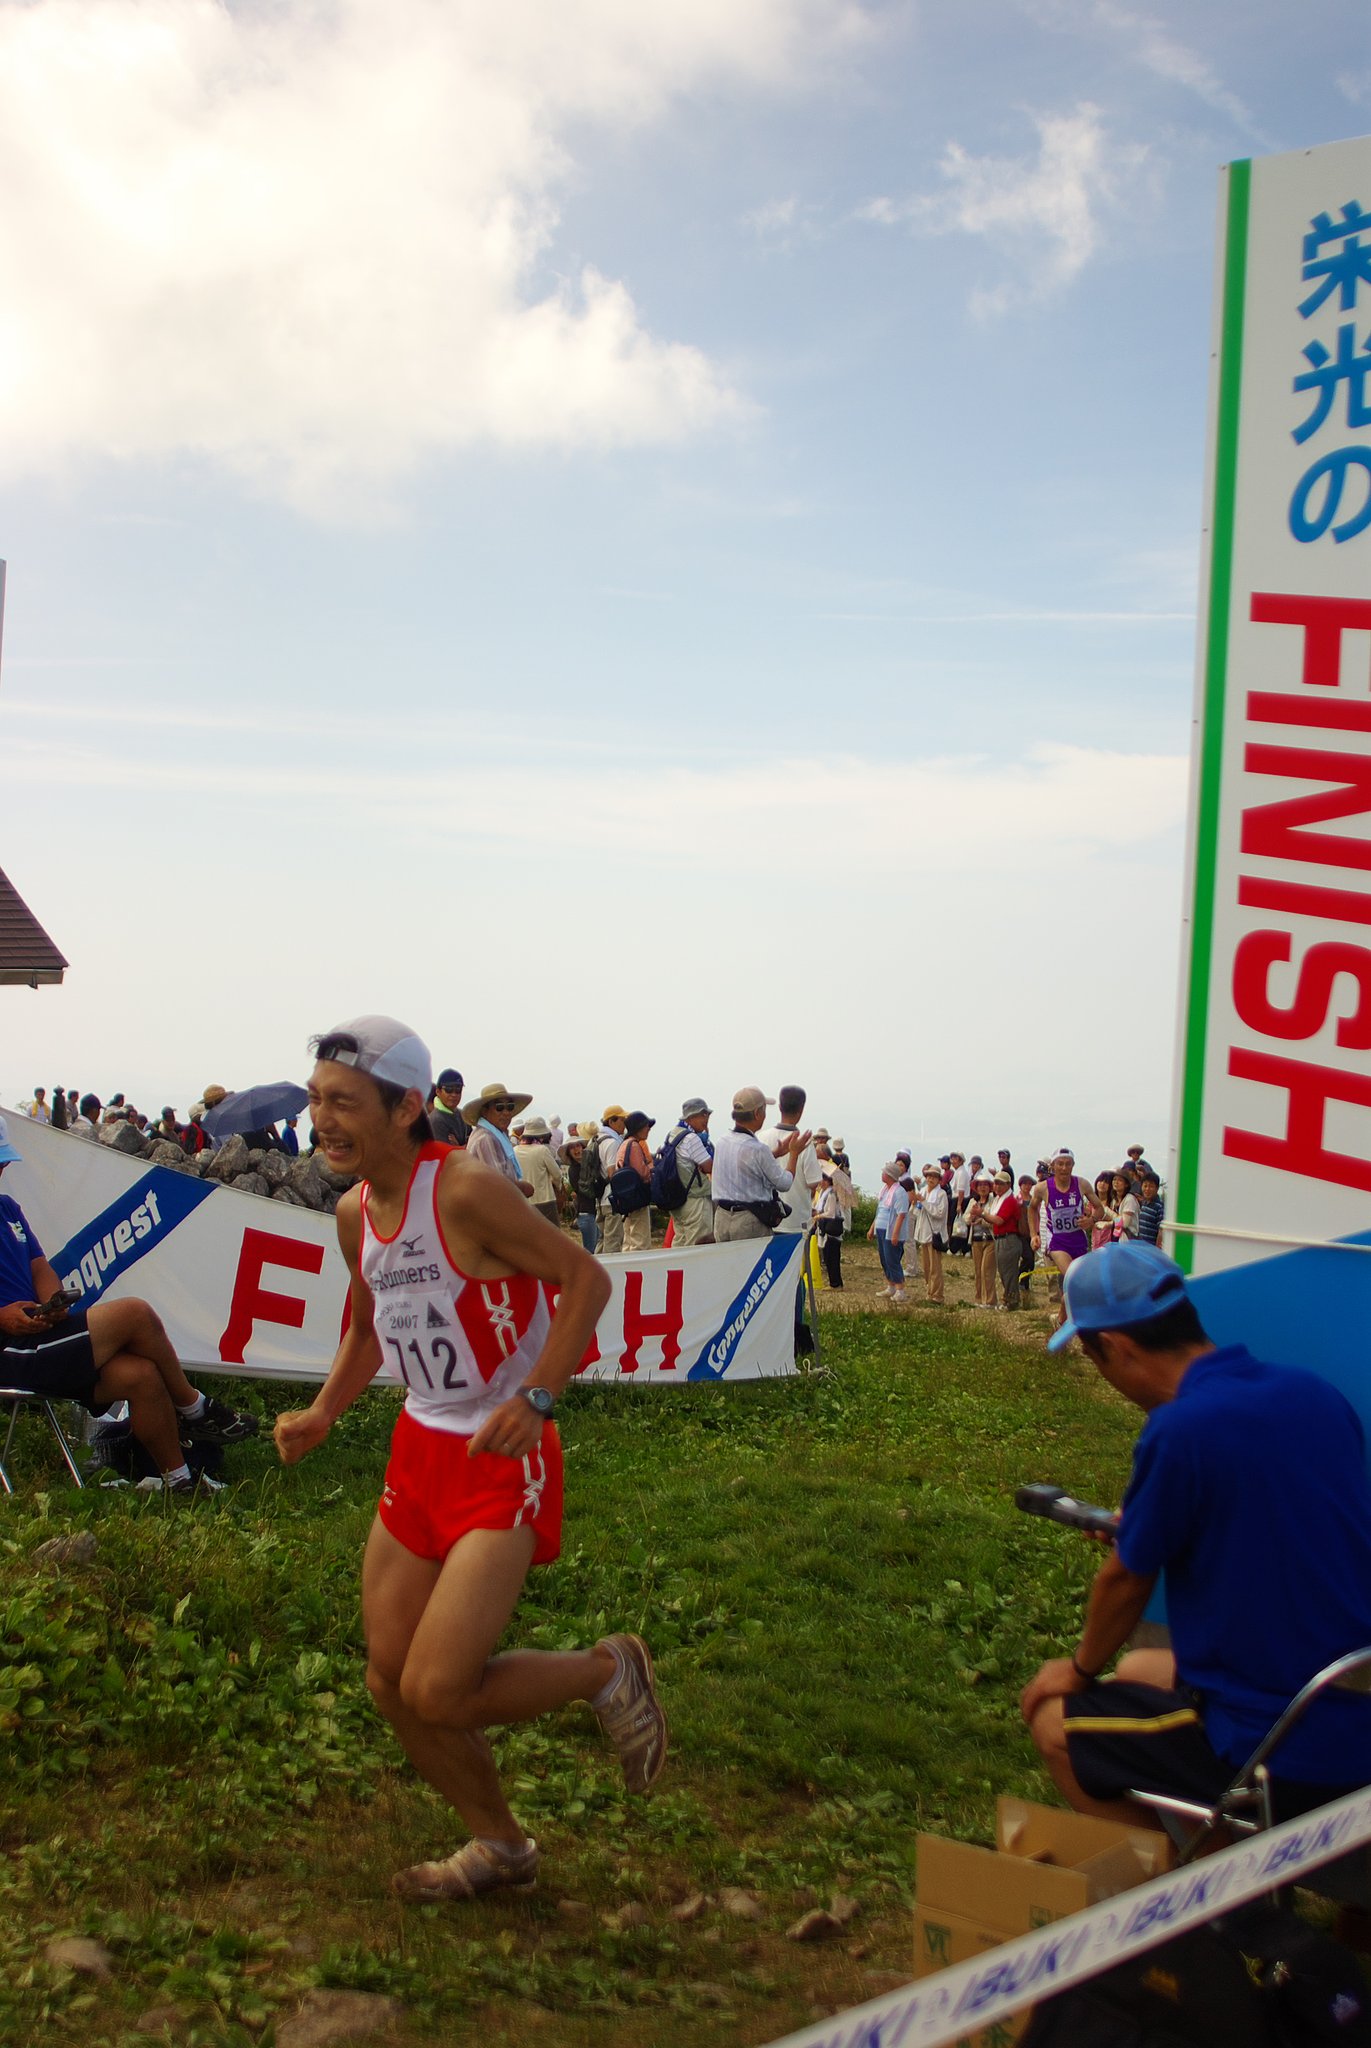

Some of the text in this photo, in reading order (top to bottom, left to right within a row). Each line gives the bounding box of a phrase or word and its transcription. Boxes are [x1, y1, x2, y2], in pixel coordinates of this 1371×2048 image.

[1221, 591, 1371, 1193] FINISH
[60, 1188, 162, 1298] nquest
[389, 1314, 419, 1329] 2007
[385, 1336, 469, 1390] 712
